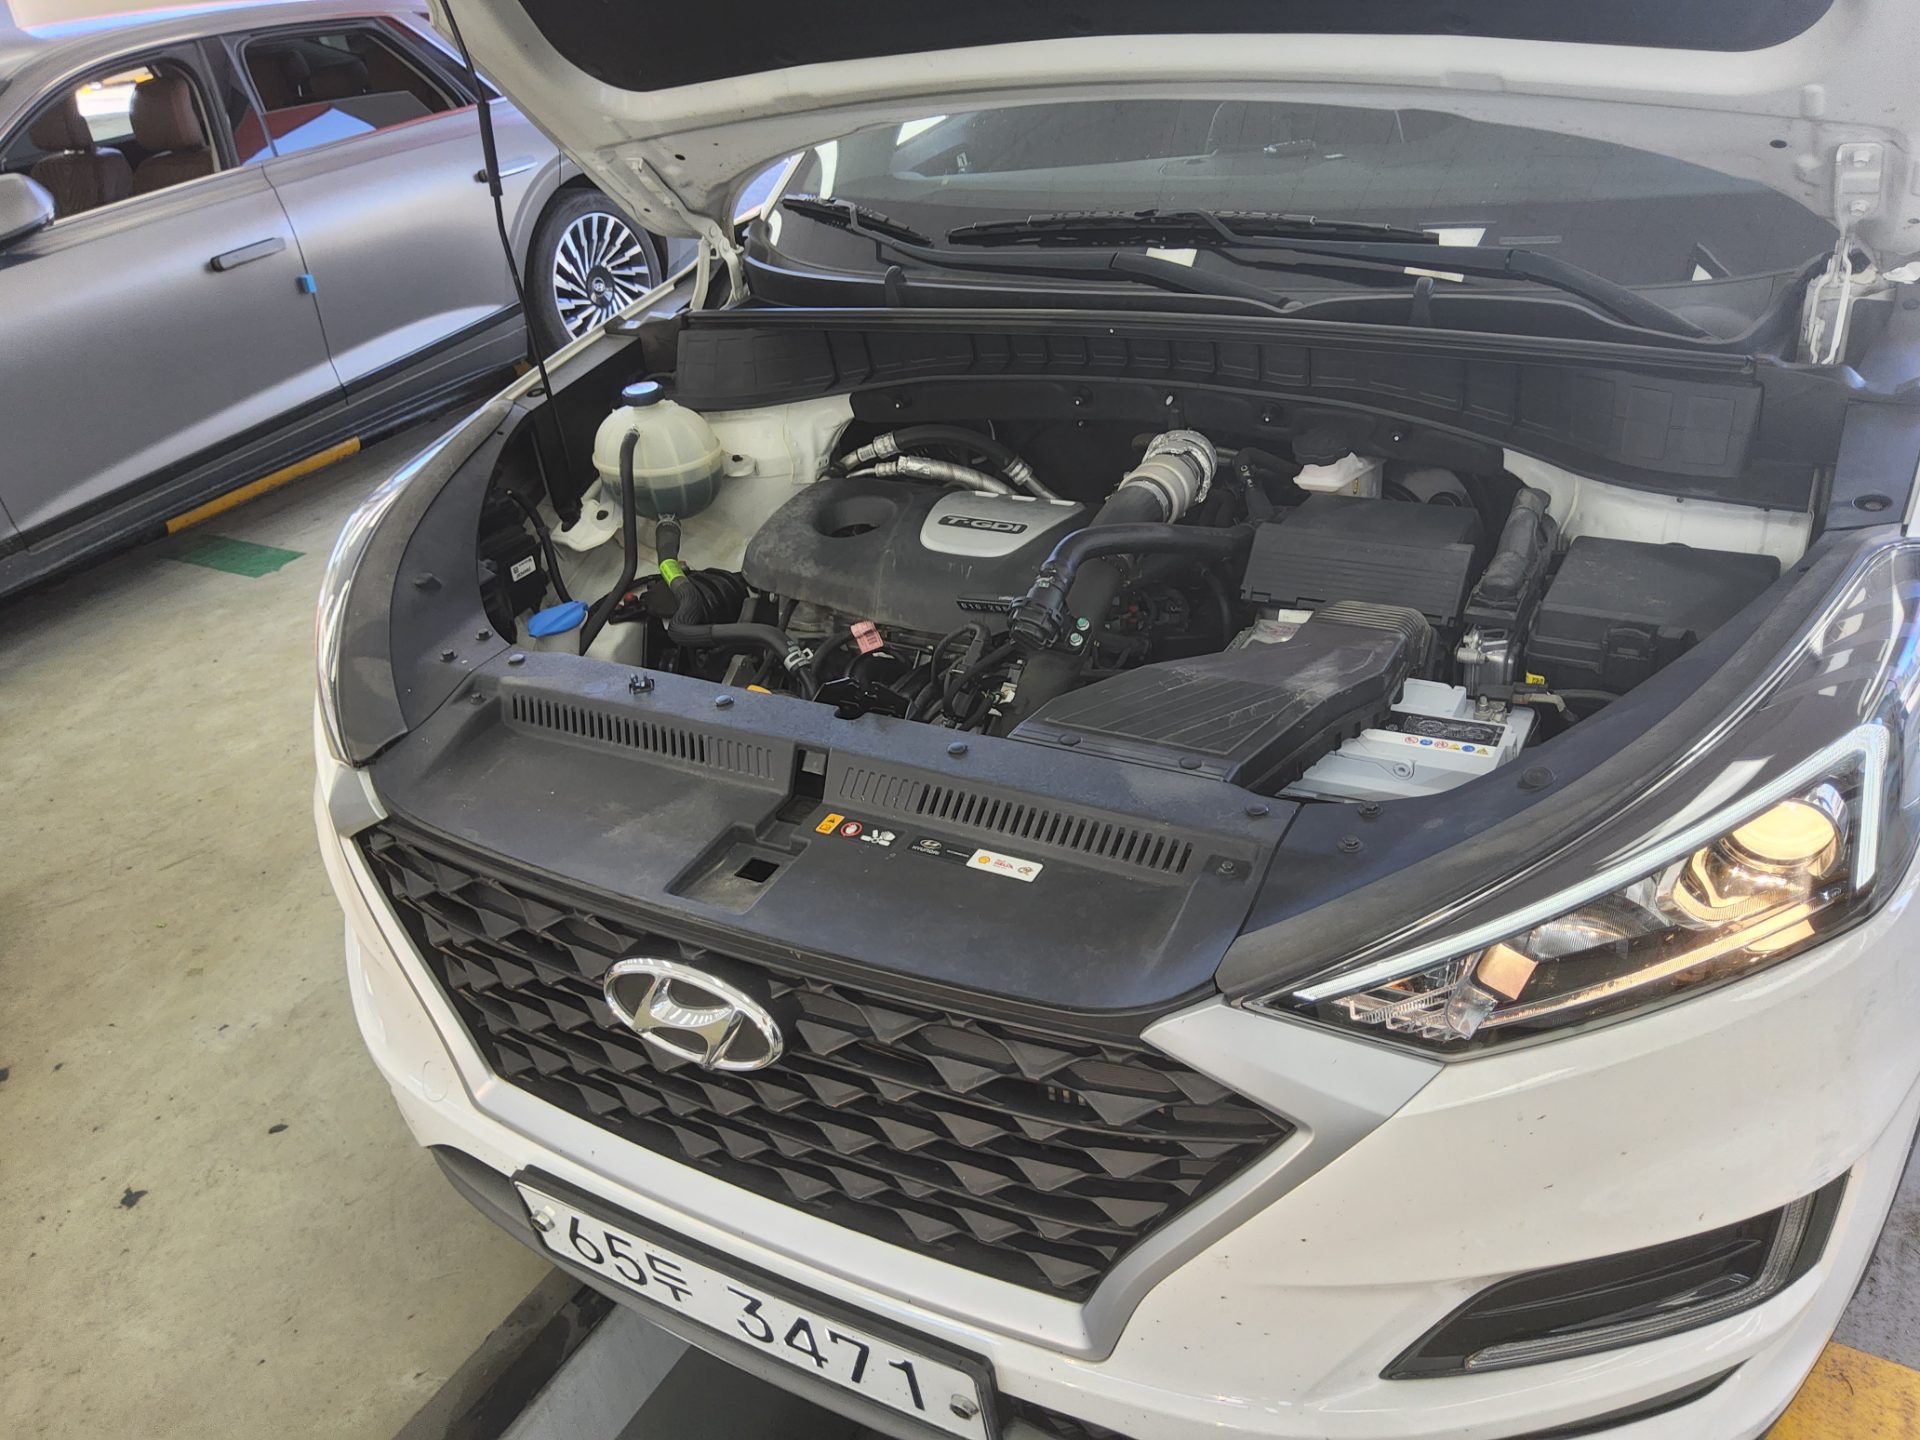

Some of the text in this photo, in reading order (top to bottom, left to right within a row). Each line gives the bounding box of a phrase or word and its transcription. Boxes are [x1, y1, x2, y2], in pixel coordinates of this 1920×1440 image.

[911, 845, 940, 856] HYUNDAI
[567, 1215, 925, 1411] 65두 3471
